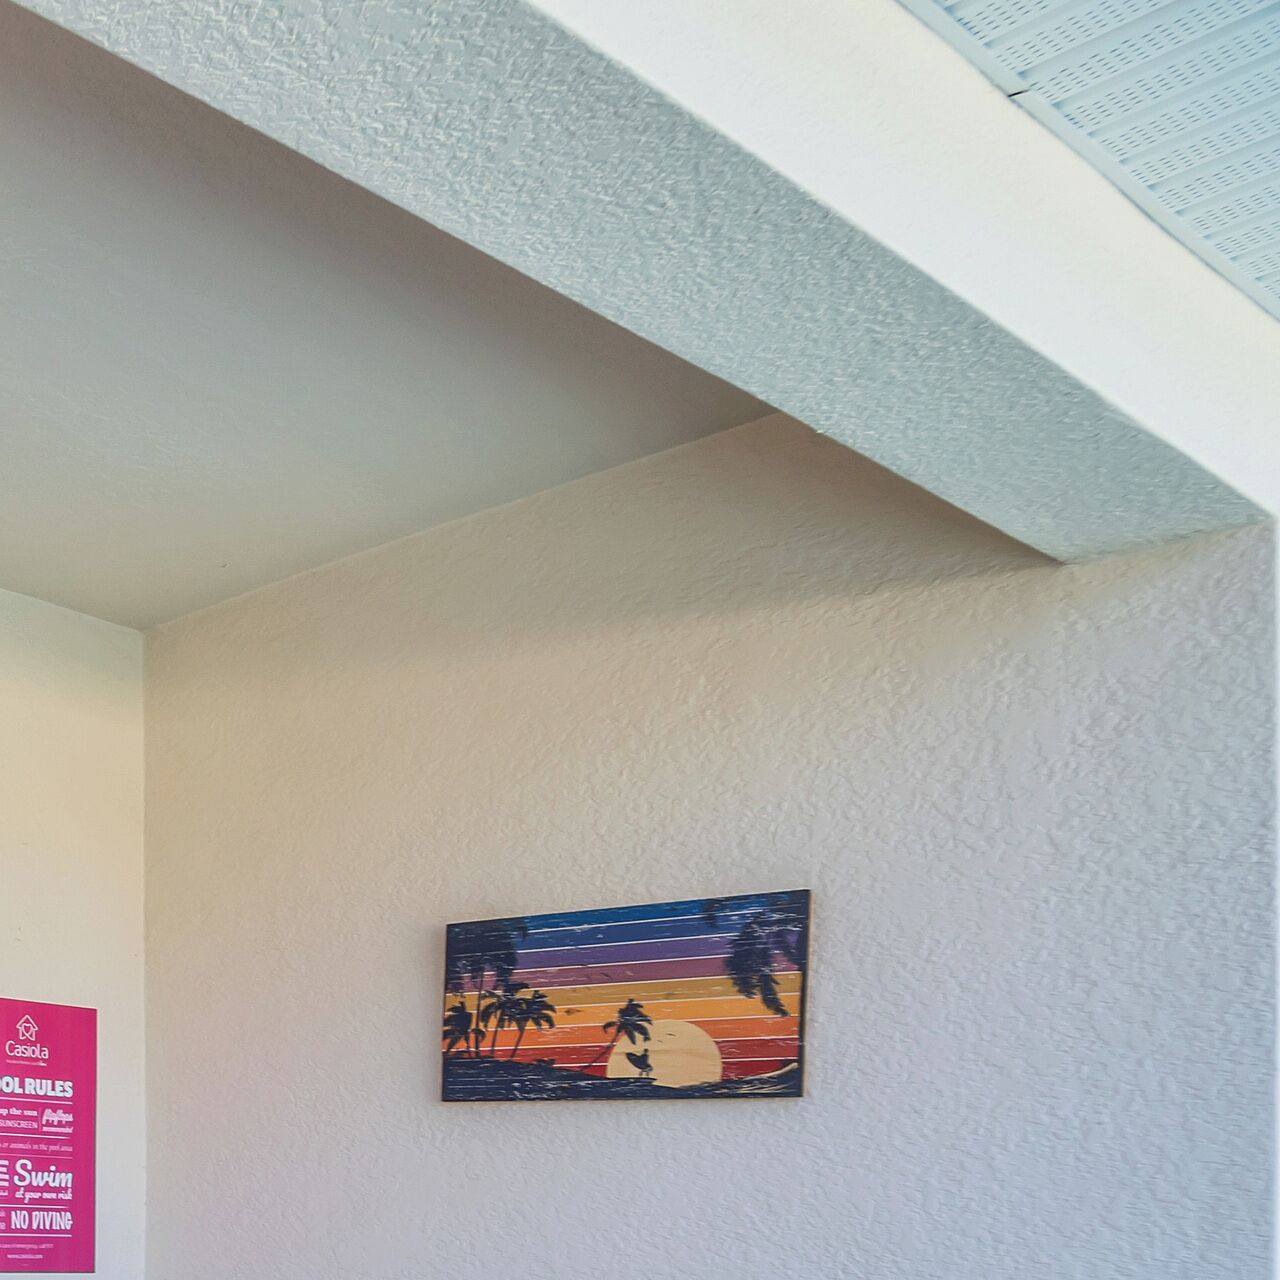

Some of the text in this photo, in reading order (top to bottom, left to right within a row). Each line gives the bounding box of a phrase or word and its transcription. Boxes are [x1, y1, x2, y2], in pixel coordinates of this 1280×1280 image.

[5, 1040, 49, 1059] Casiola
[24, 1077, 73, 1098] RULES
[13, 1159, 73, 1188] Swim
[15, 1187, 24, 1198] at
[24, 1191, 42, 1204] your
[58, 1188, 73, 1200] risk
[11, 1210, 29, 1230] NO
[32, 1211, 73, 1231] DIVING
